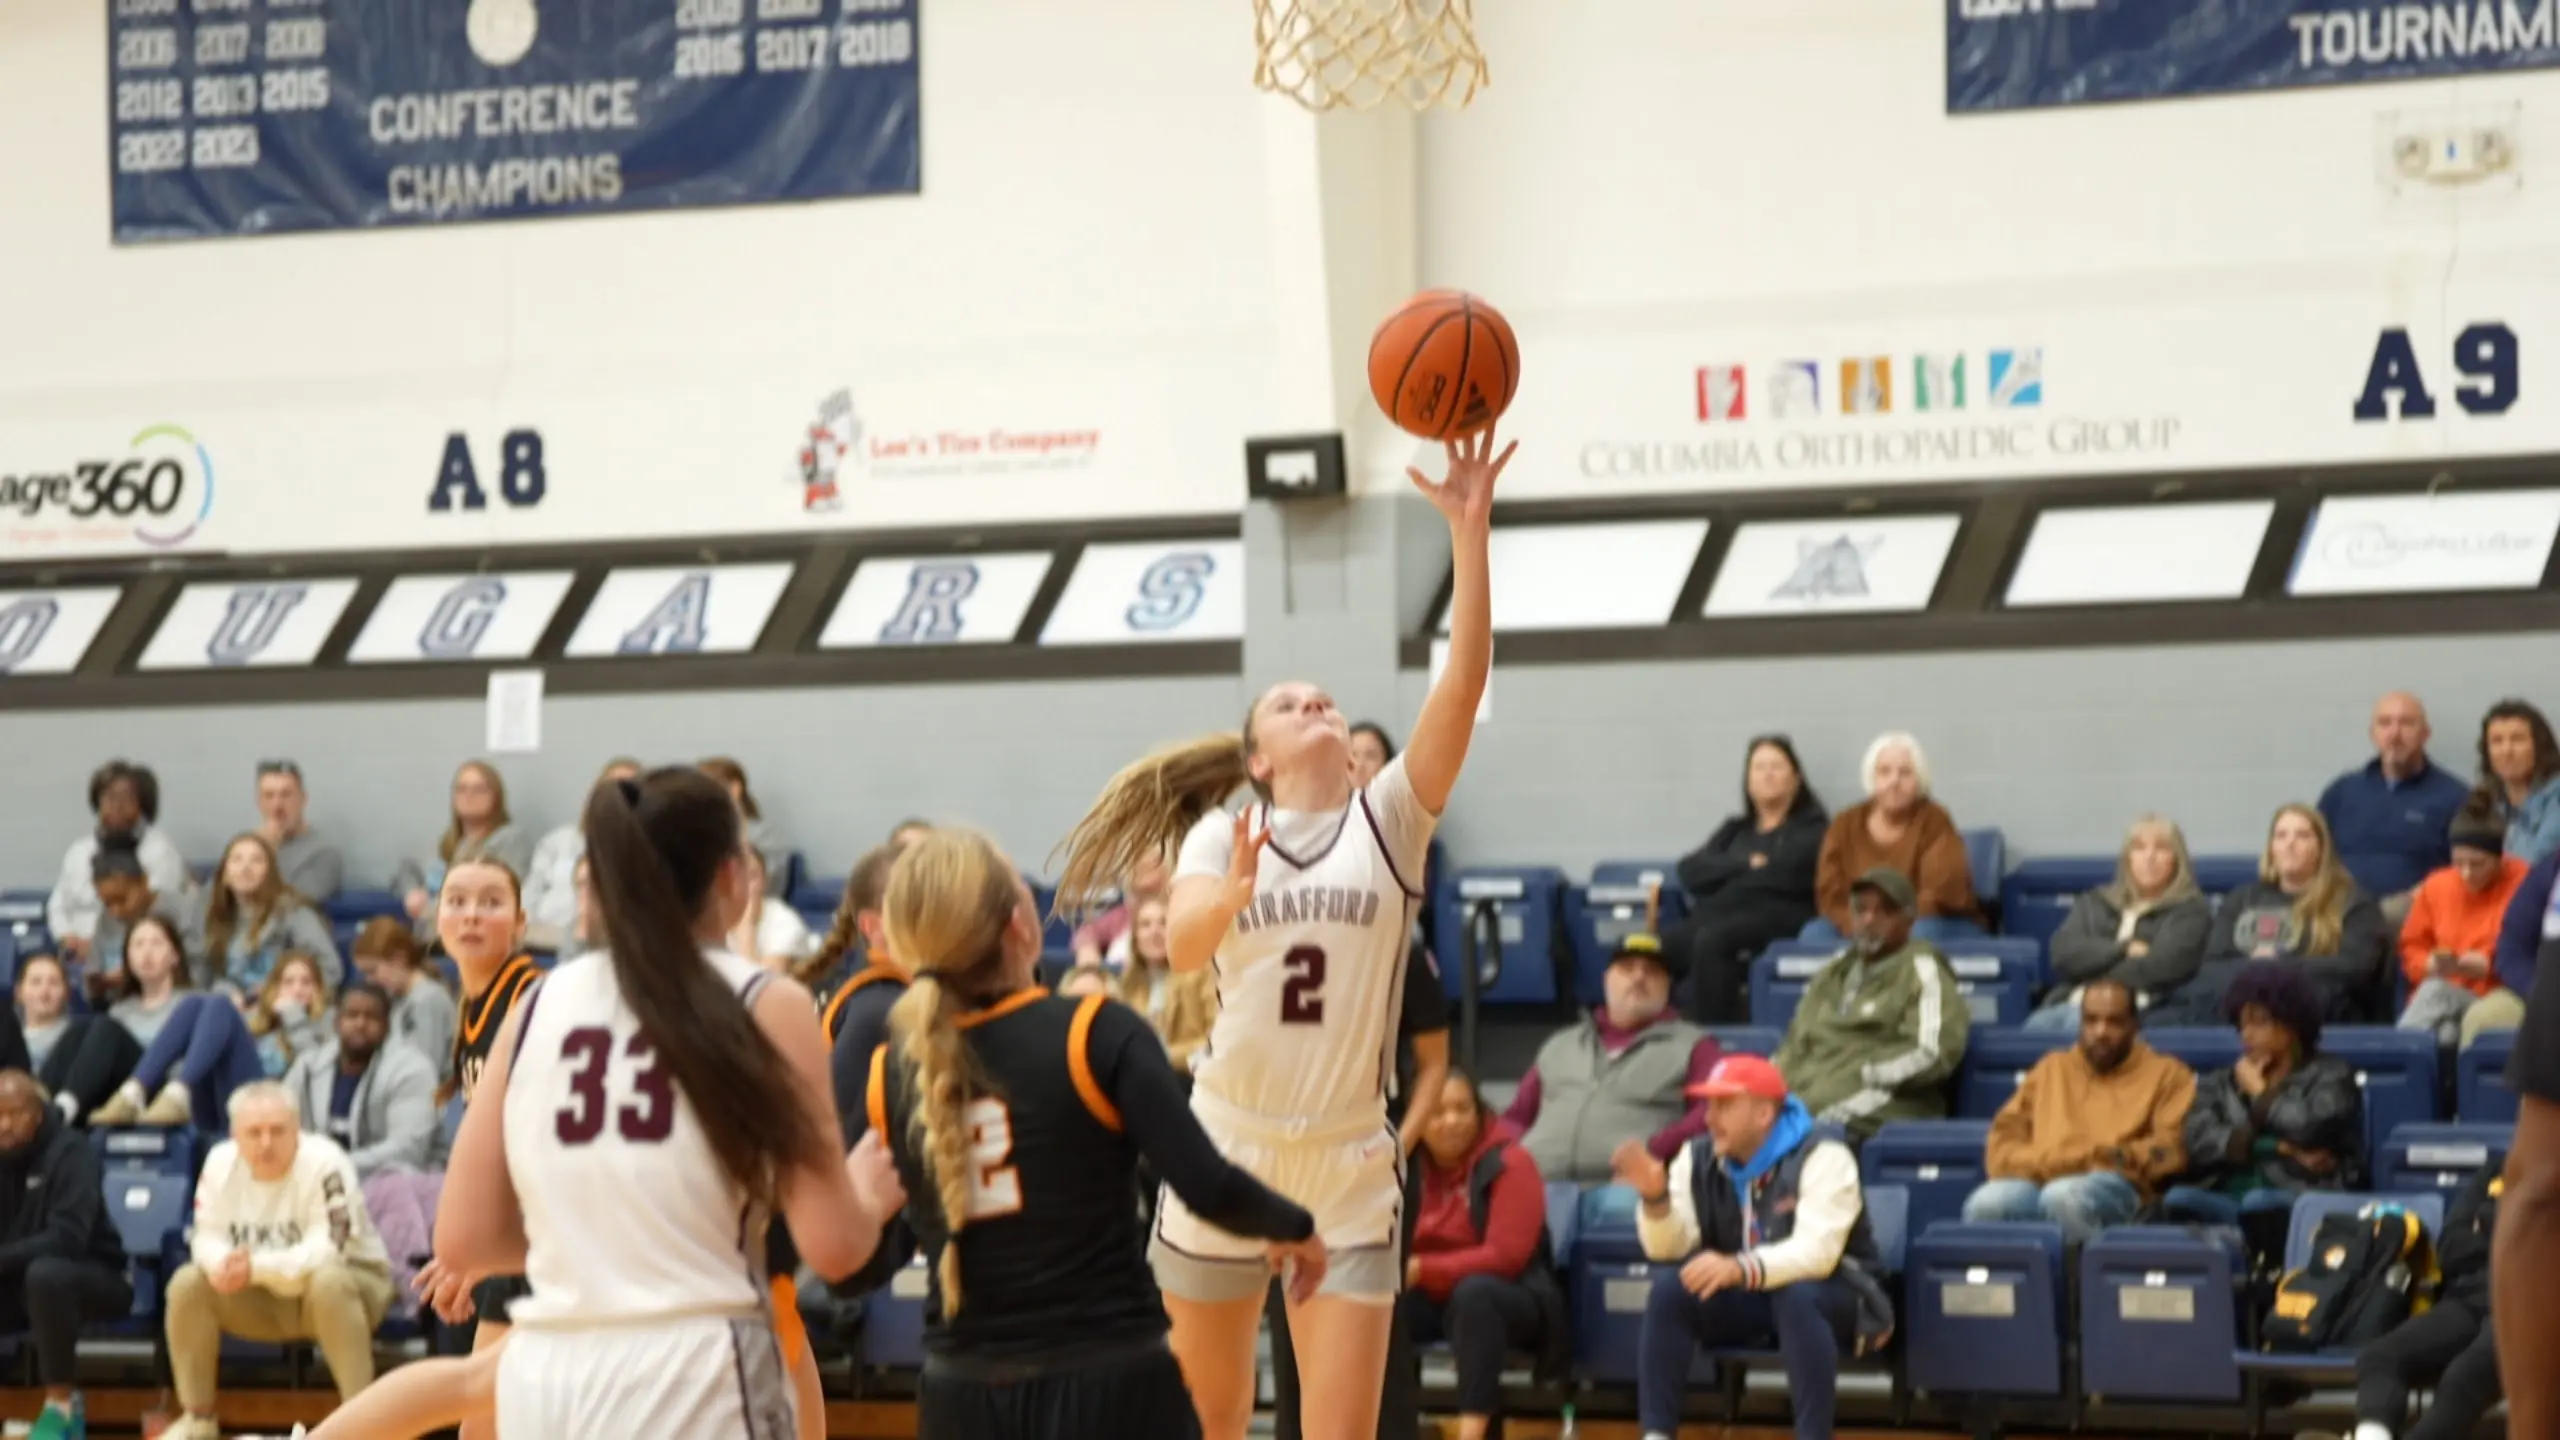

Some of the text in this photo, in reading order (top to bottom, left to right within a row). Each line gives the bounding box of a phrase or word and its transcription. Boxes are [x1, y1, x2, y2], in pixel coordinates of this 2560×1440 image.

[195, 22, 249, 65] 2007
[756, 26, 828, 72] 2017
[840, 19, 911, 67] 2018
[2290, 0, 2560, 68] TOURNAM
[117, 67, 330, 121] 2012 2013 2015
[370, 79, 639, 143] CONFERENCE
[118, 124, 258, 173] 2022 2023
[388, 153, 623, 213] CHAMPIONS
[2353, 322, 2519, 422] A9
[428, 429, 545, 513] A8
[938, 431, 982, 455] Tire
[988, 429, 1101, 455] Company
[1579, 416, 2182, 478] COLUMBIA ORTHOPAEDIC GROUP
[1280, 943, 1327, 1025] 2
[556, 1027, 675, 1143] 33
